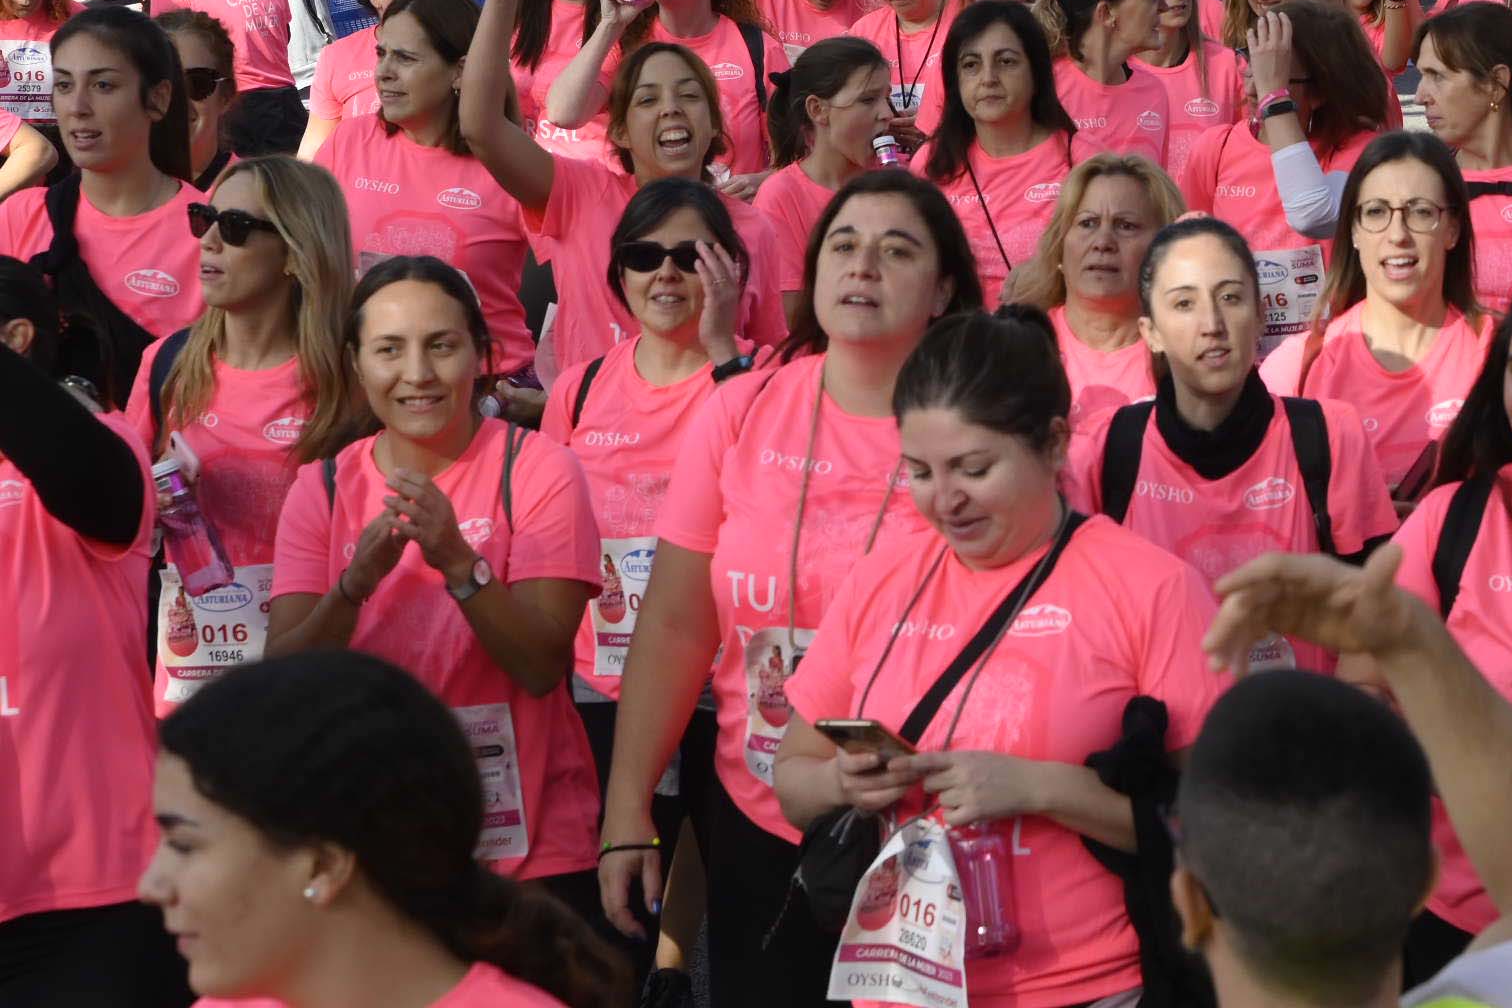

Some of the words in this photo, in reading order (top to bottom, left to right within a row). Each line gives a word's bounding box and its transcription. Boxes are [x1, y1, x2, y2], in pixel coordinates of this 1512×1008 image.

[14, 71, 45, 81] 016
[355, 176, 400, 194] OYSHO
[1263, 293, 1288, 307] 16
[1136, 481, 1194, 504] OYSHO
[727, 570, 776, 612] TU
[202, 623, 248, 644] 016
[209, 650, 243, 662] 16946
[900, 894, 936, 928] 016
